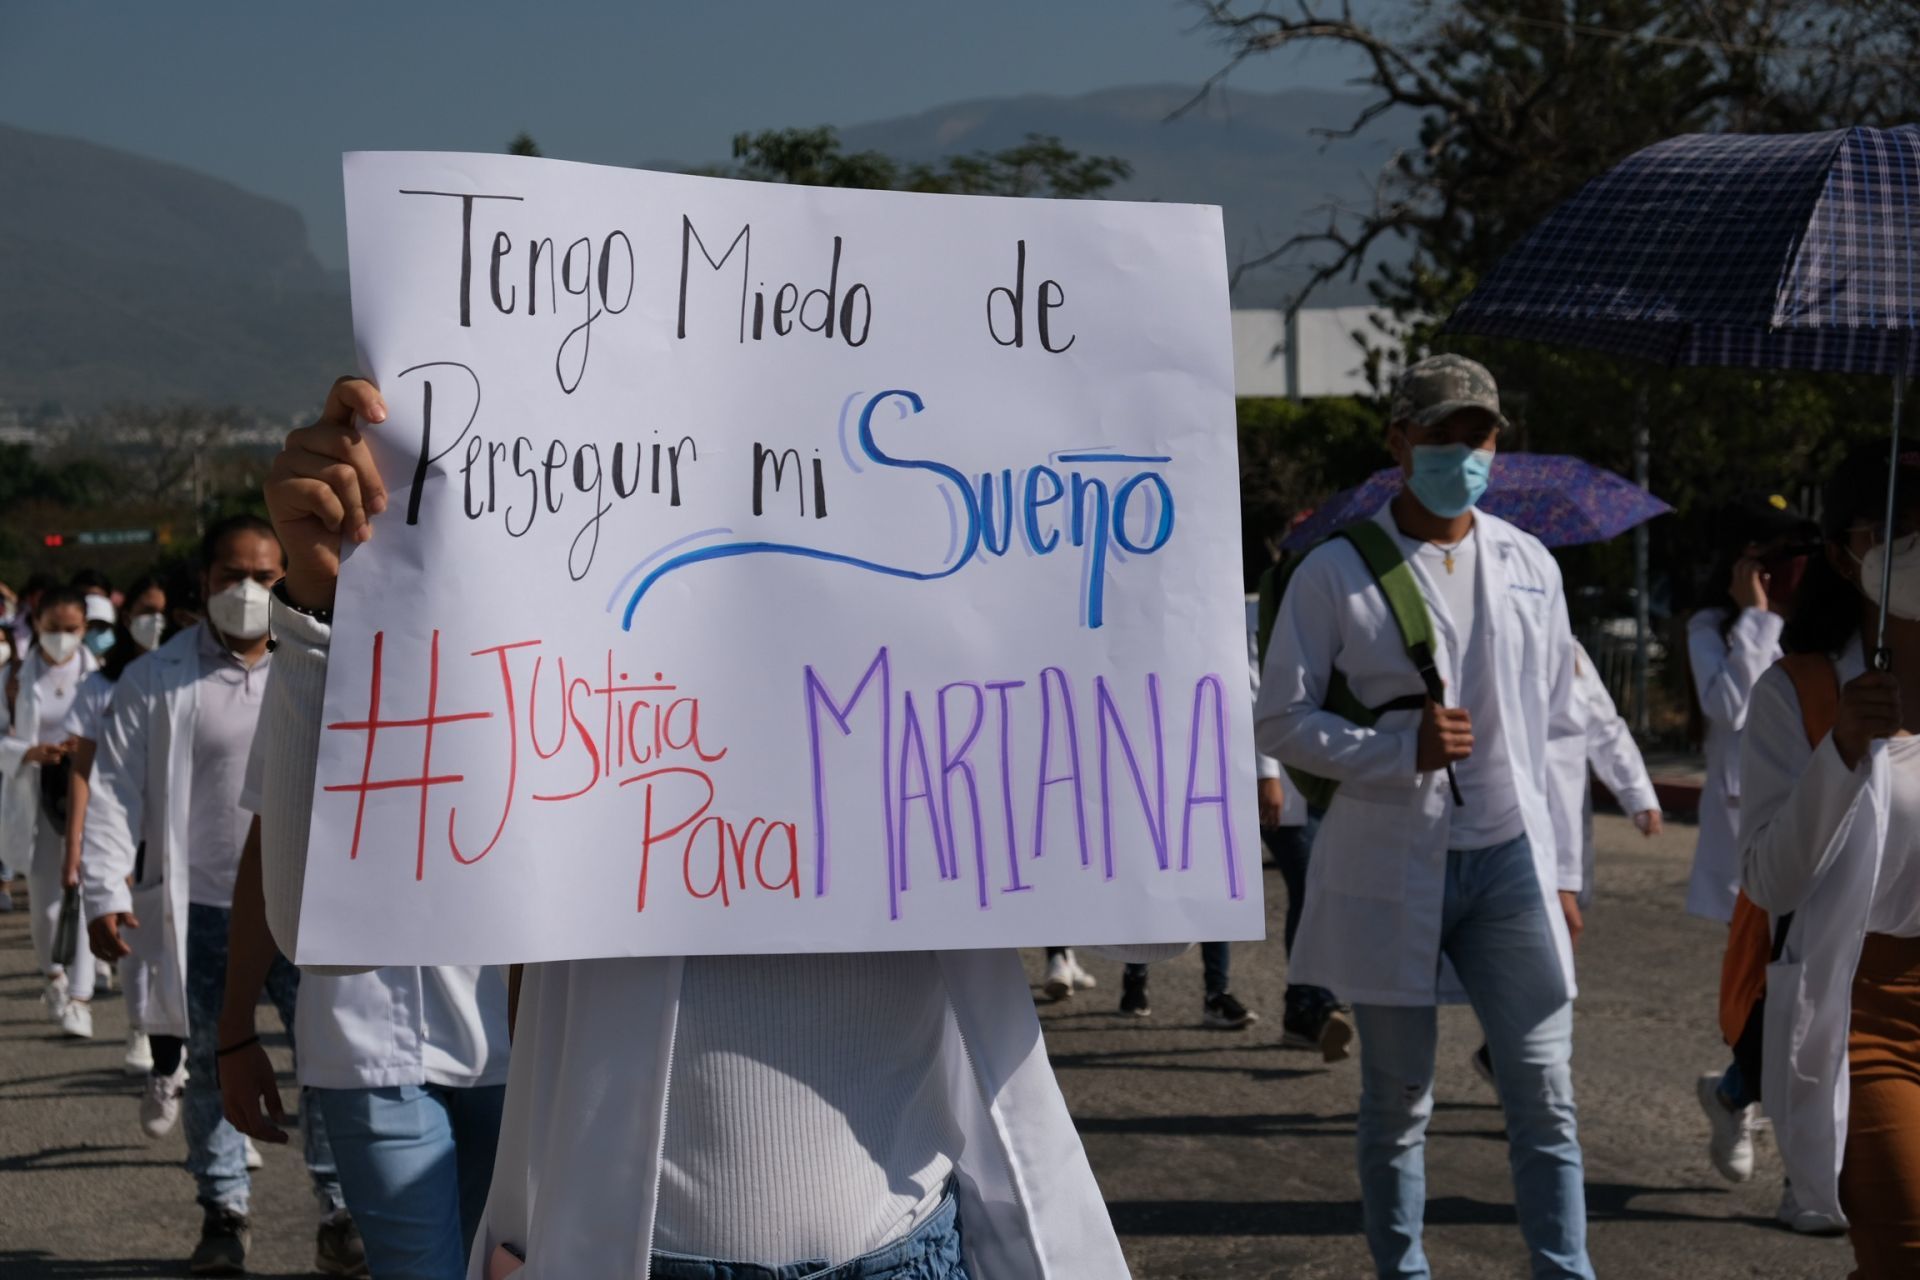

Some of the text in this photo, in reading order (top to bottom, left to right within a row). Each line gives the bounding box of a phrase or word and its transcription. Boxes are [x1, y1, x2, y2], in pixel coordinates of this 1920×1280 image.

[398, 189, 1075, 394] Tengo Miedo de
[398, 361, 1172, 628] Perseguir mi Sueño
[620, 646, 1242, 921] Para MARIANA
